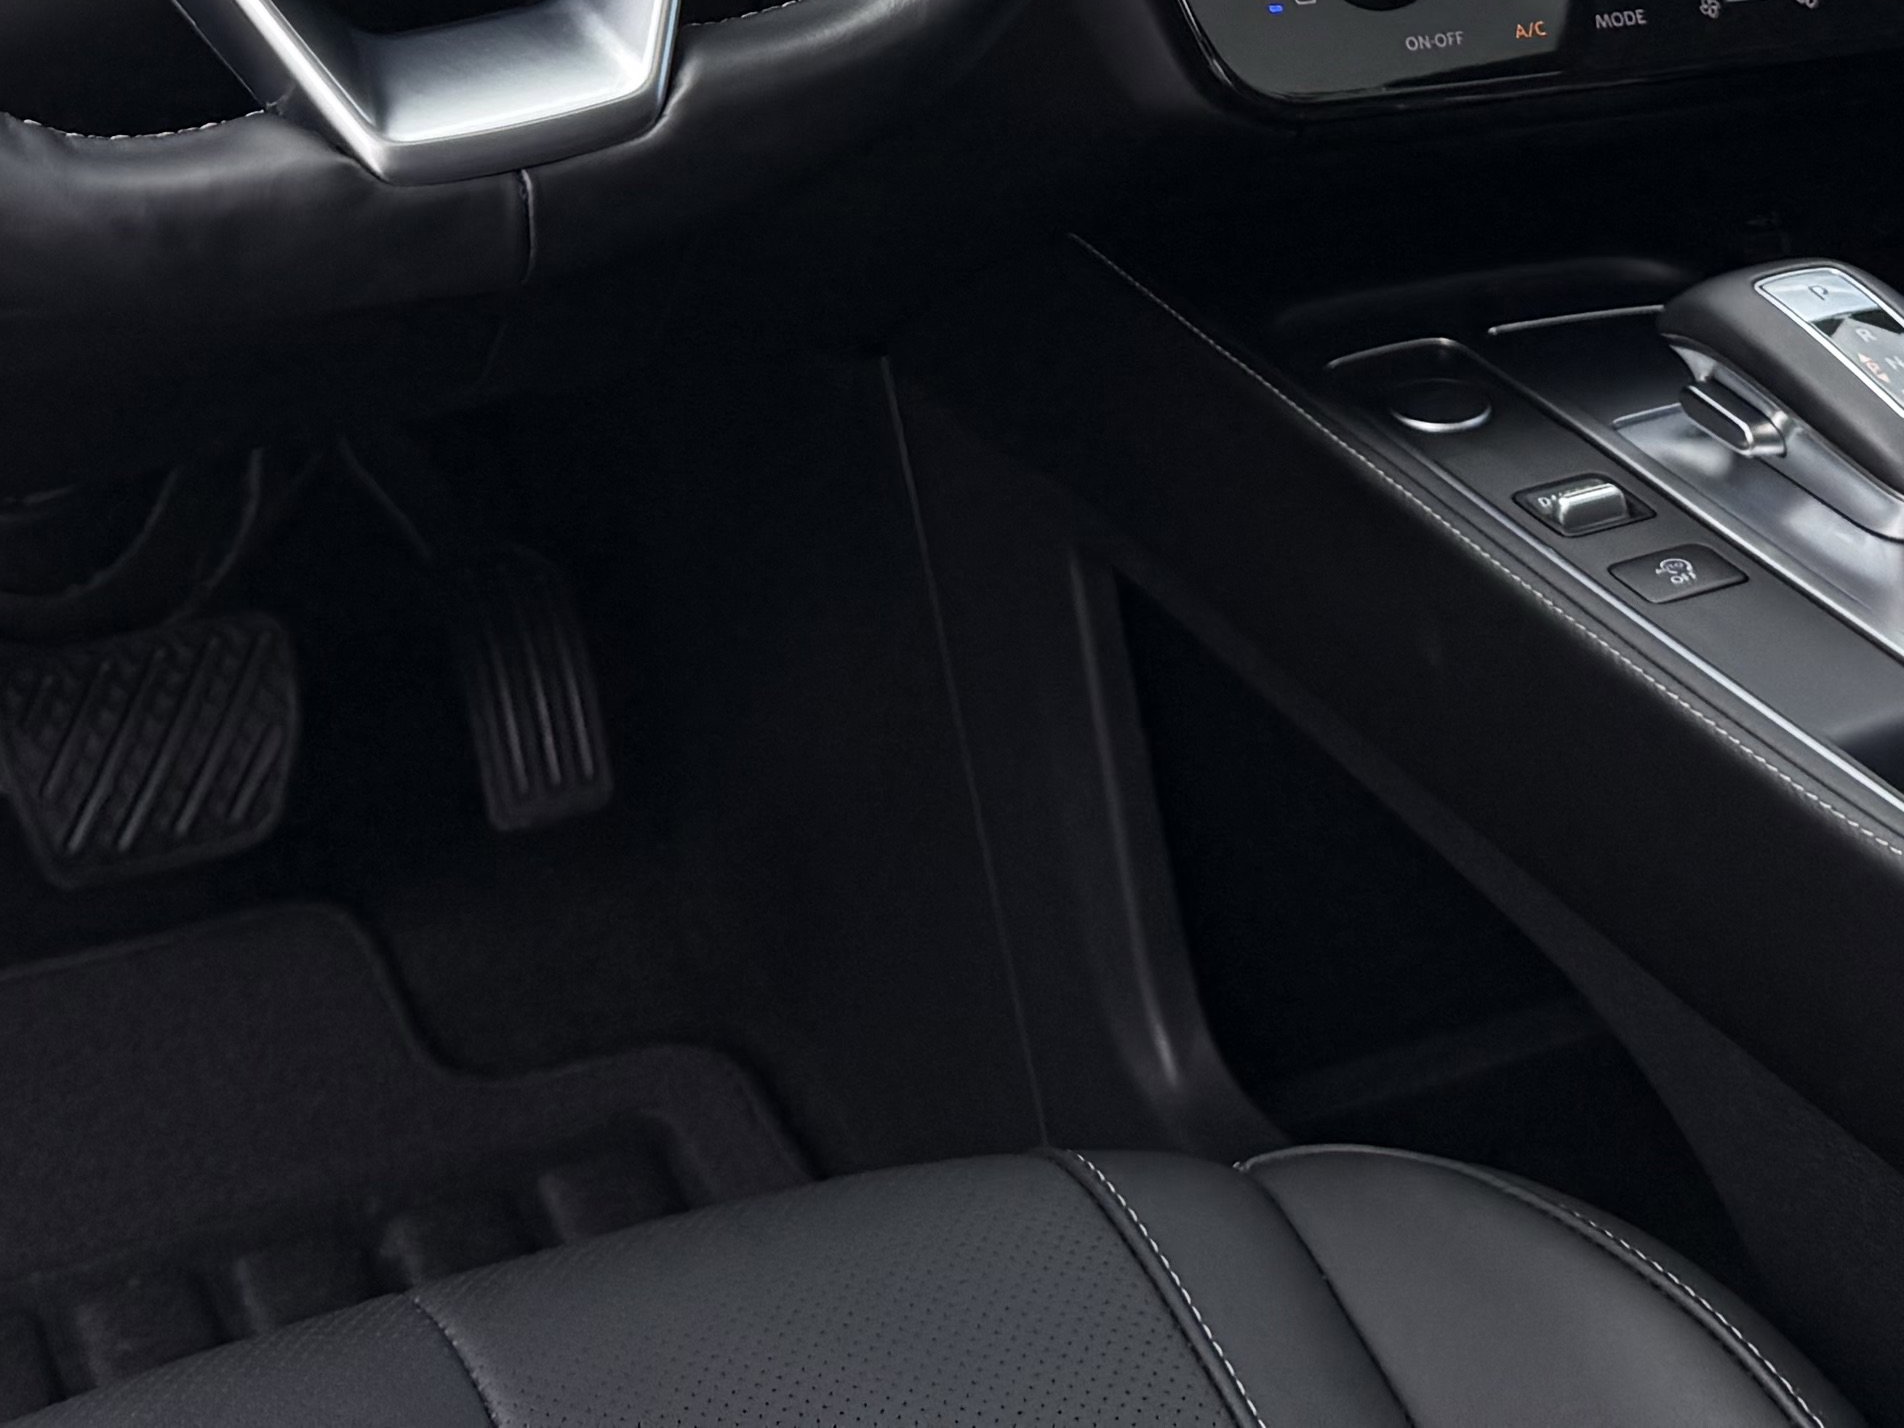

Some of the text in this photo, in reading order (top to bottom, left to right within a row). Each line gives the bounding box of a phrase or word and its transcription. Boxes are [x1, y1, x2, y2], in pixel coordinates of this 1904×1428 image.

[1596, 9, 1647, 29] MODE
[1516, 20, 1547, 39] A/C
[1808, 285, 1829, 302] P
[1856, 328, 1877, 343] R
